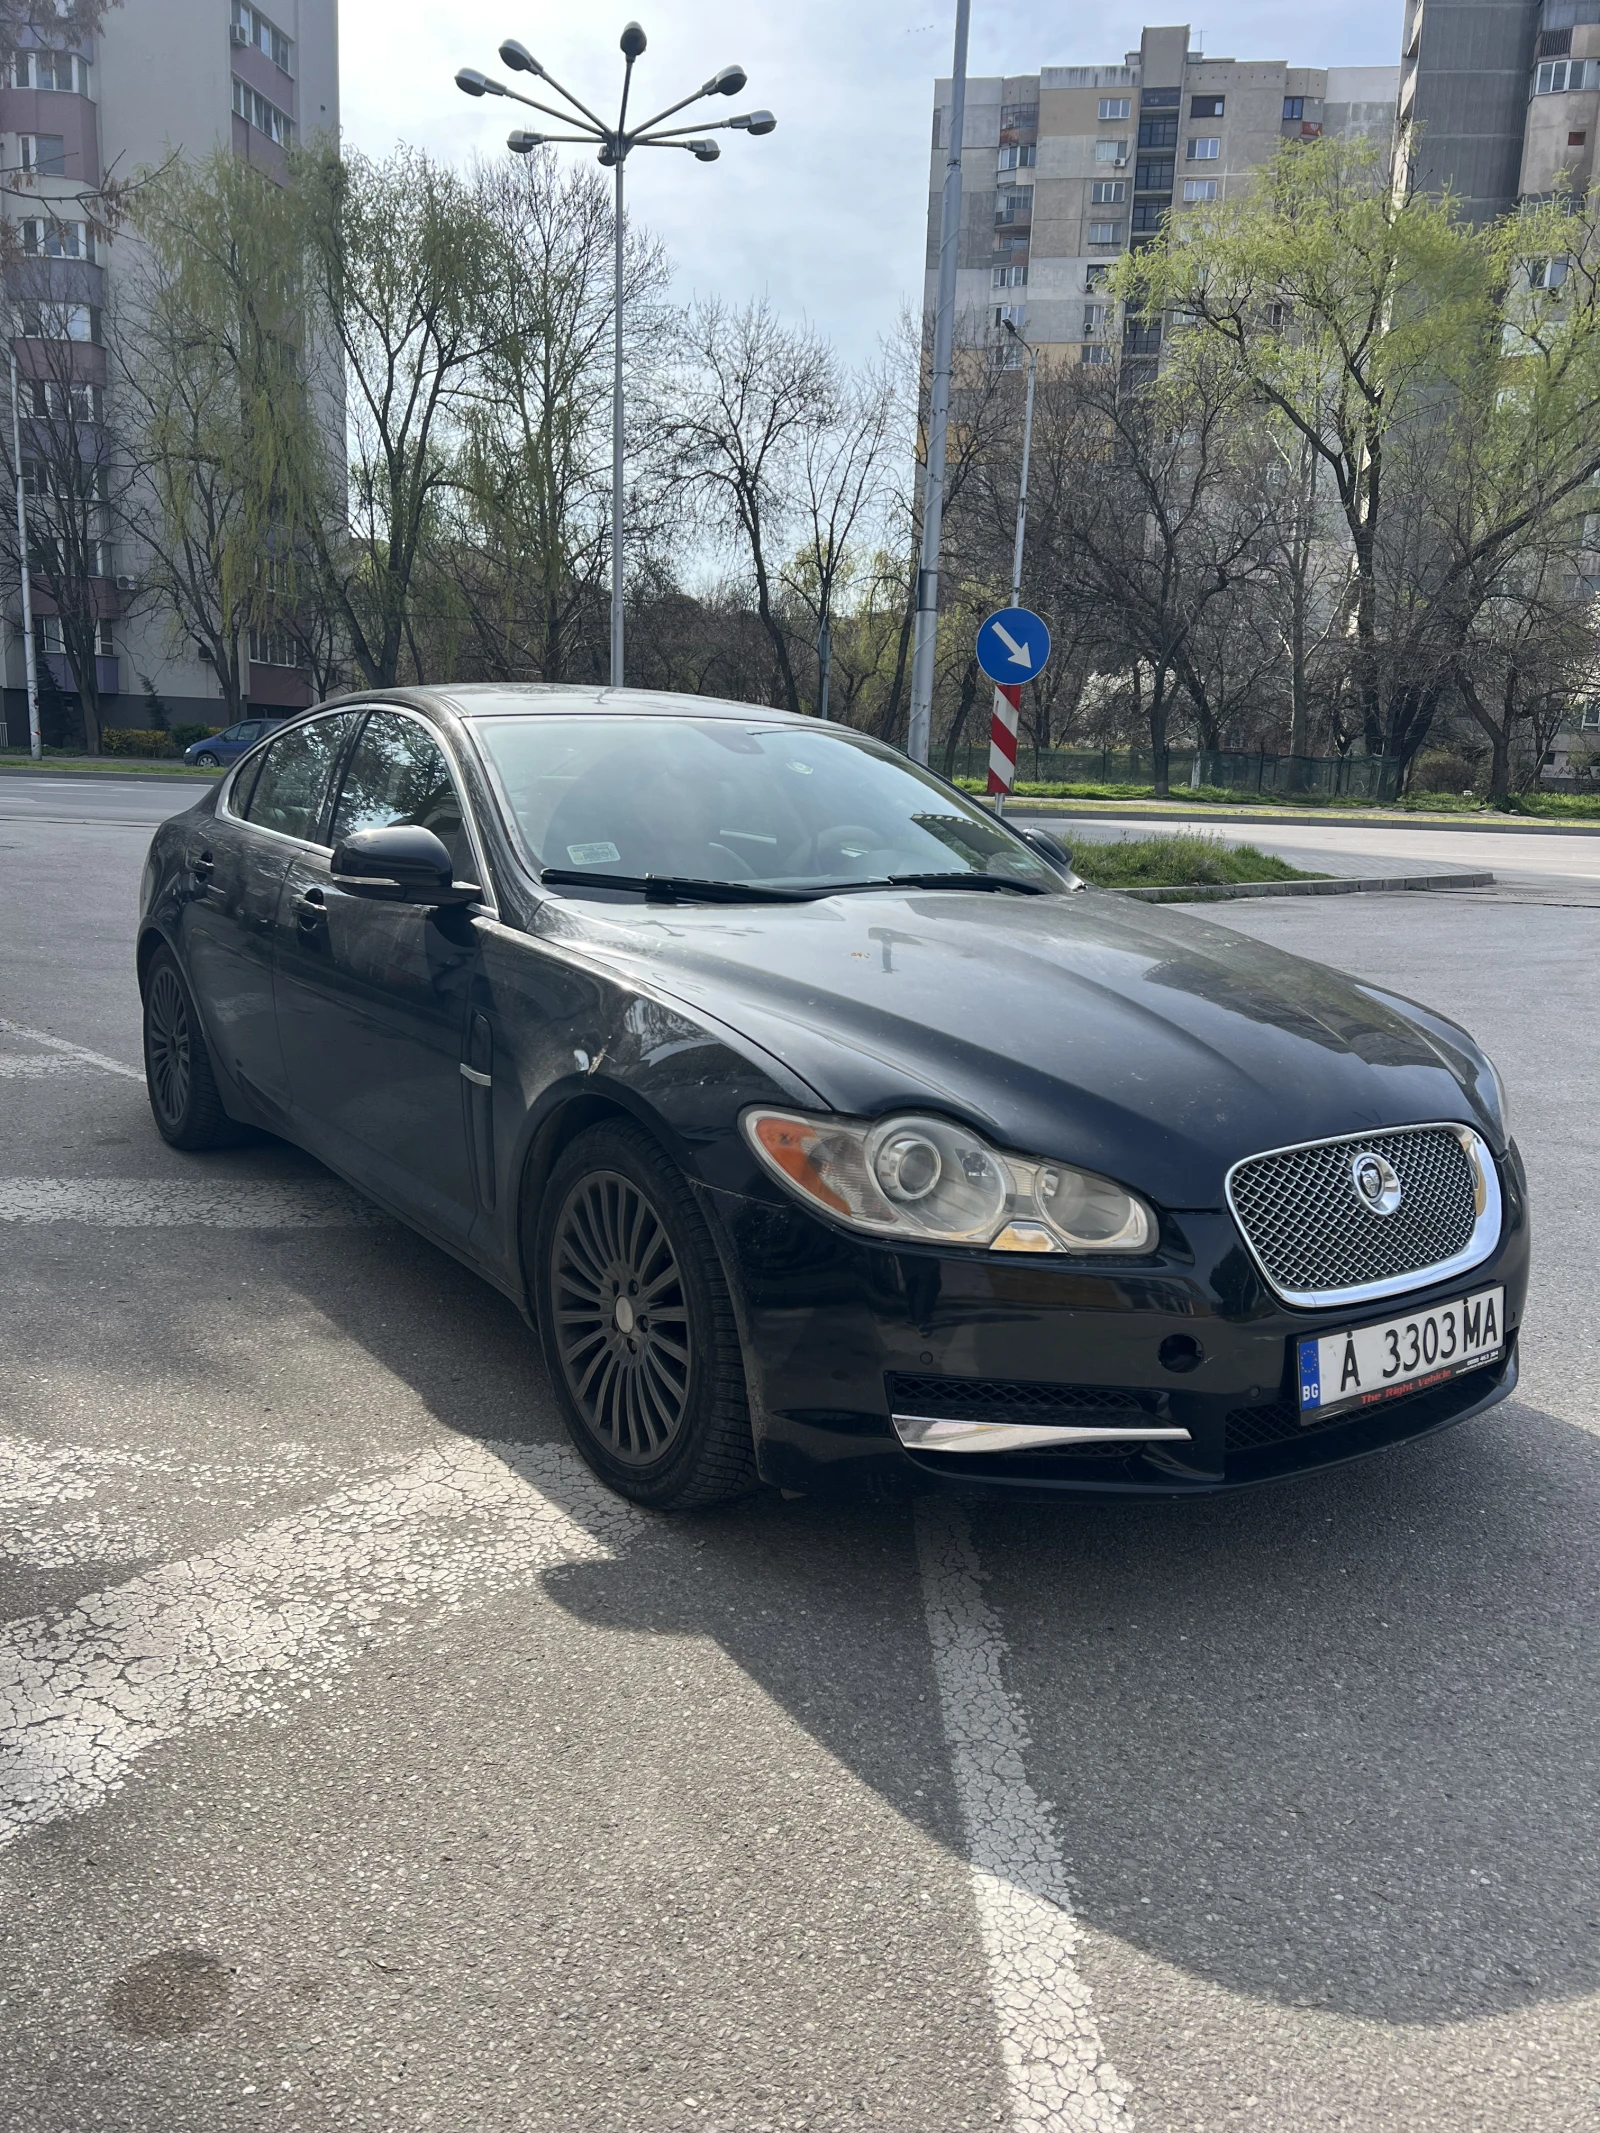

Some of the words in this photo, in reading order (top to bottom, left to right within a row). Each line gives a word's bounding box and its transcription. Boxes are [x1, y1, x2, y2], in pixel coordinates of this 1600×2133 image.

[1340, 1338, 1361, 1392] A
[1382, 1311, 1457, 1379] 3303
[1463, 1298, 1498, 1353] MA
[1302, 1383, 1319, 1401] BG
[1361, 1393, 1381, 1404] The
[1385, 1383, 1414, 1397] Right
[1418, 1369, 1451, 1387] Vehicle
